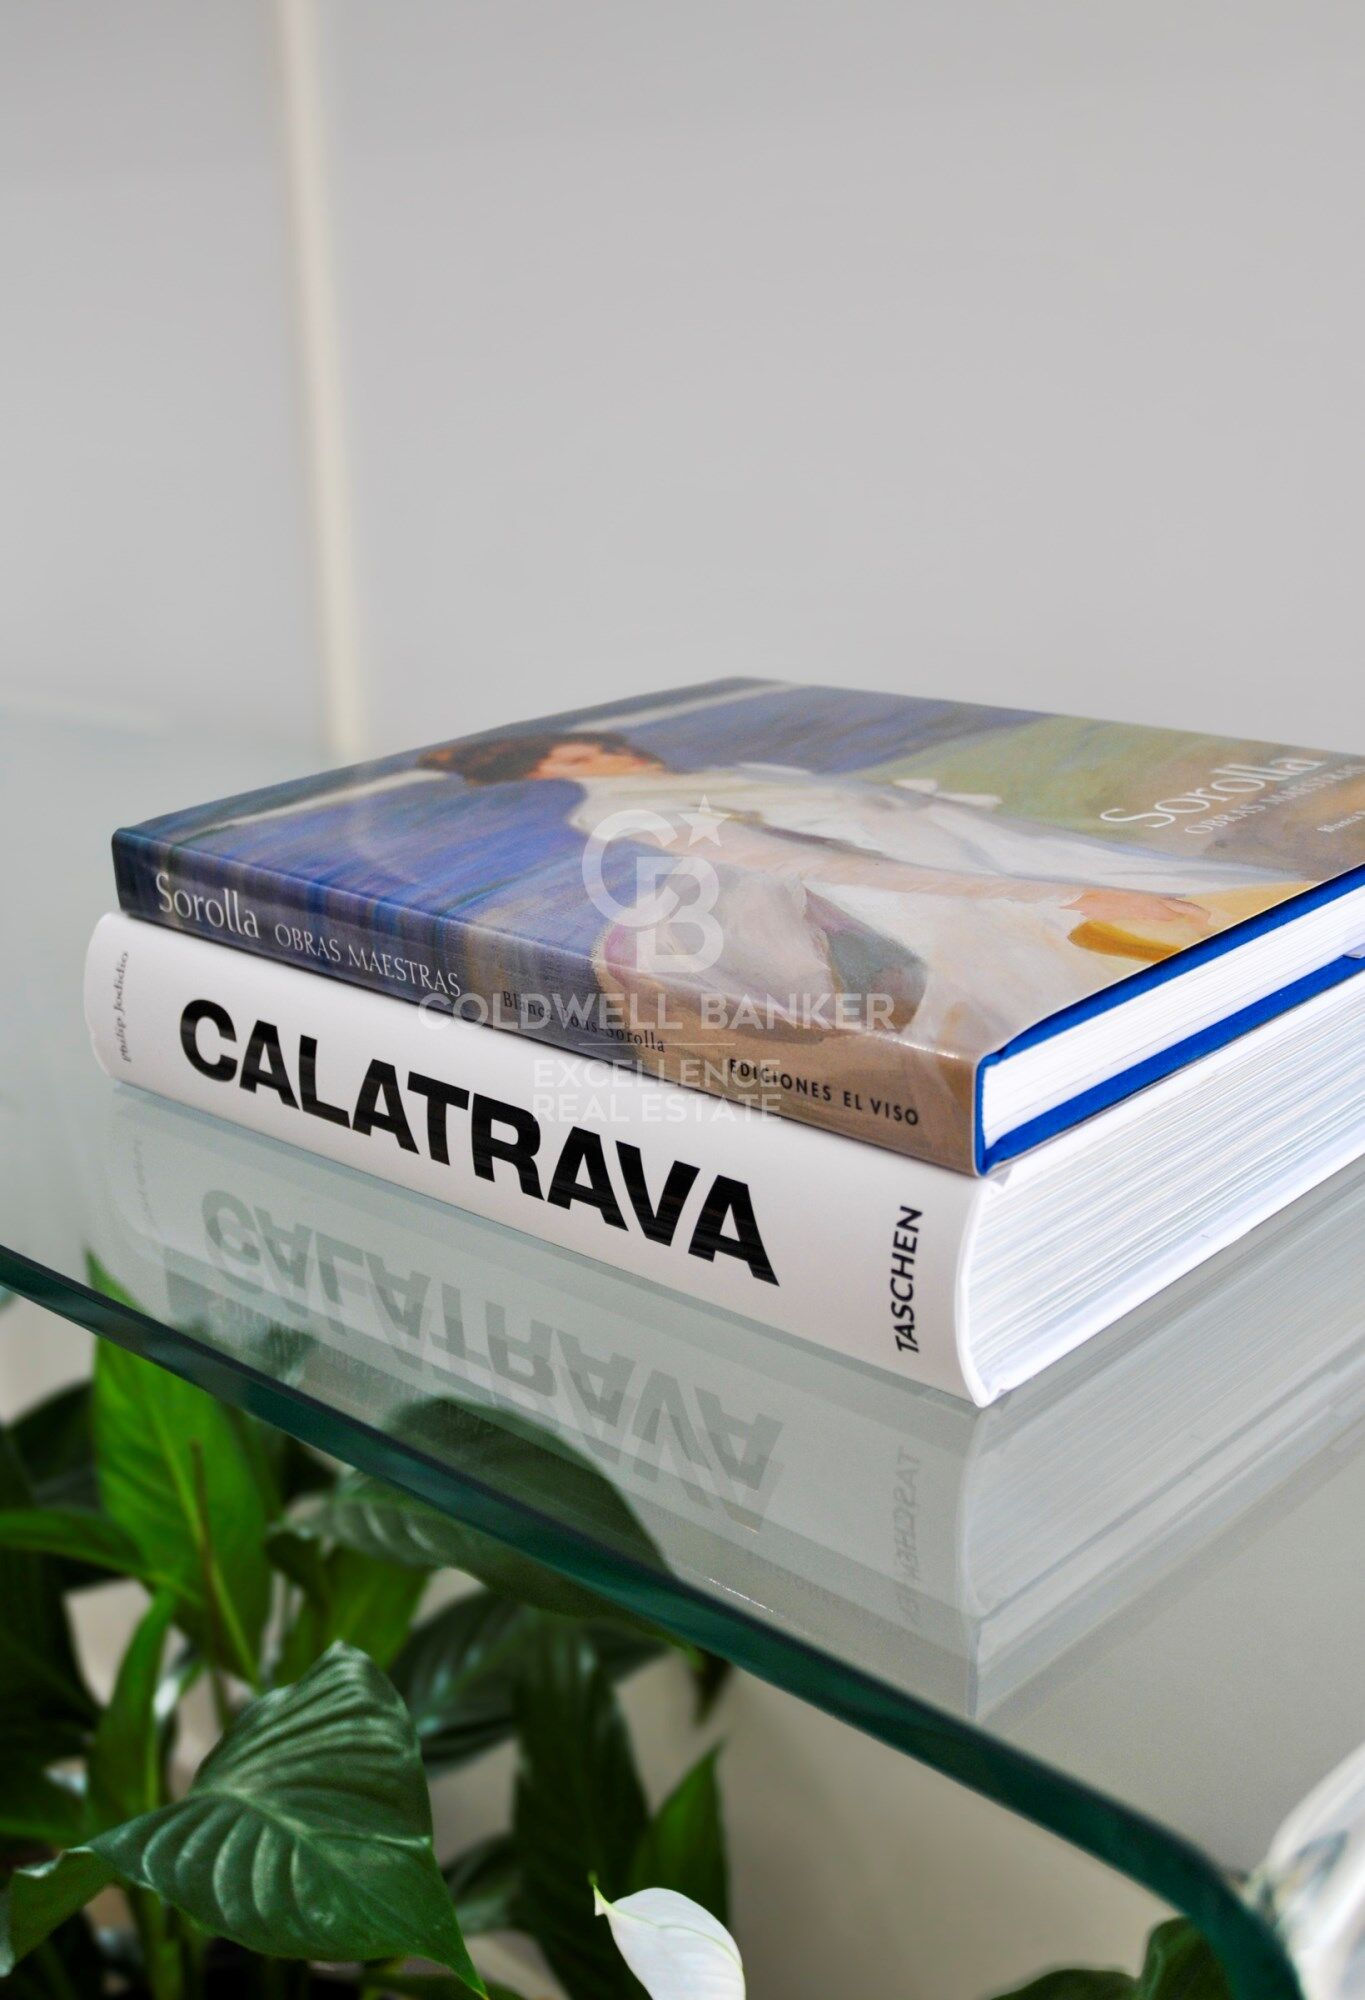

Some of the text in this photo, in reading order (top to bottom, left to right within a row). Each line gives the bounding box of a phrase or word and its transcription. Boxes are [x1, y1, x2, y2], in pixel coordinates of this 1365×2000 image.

[1100, 757, 1325, 828] Sorolla
[1184, 803, 1266, 834] OBRAS
[155, 872, 462, 998] Sorolla OBRAS MAESTRAS
[729, 1058, 919, 1126] EDICIONES EL VISO
[180, 999, 780, 1287] CALATRAVA
[890, 1205, 923, 1354] TASCHEN
